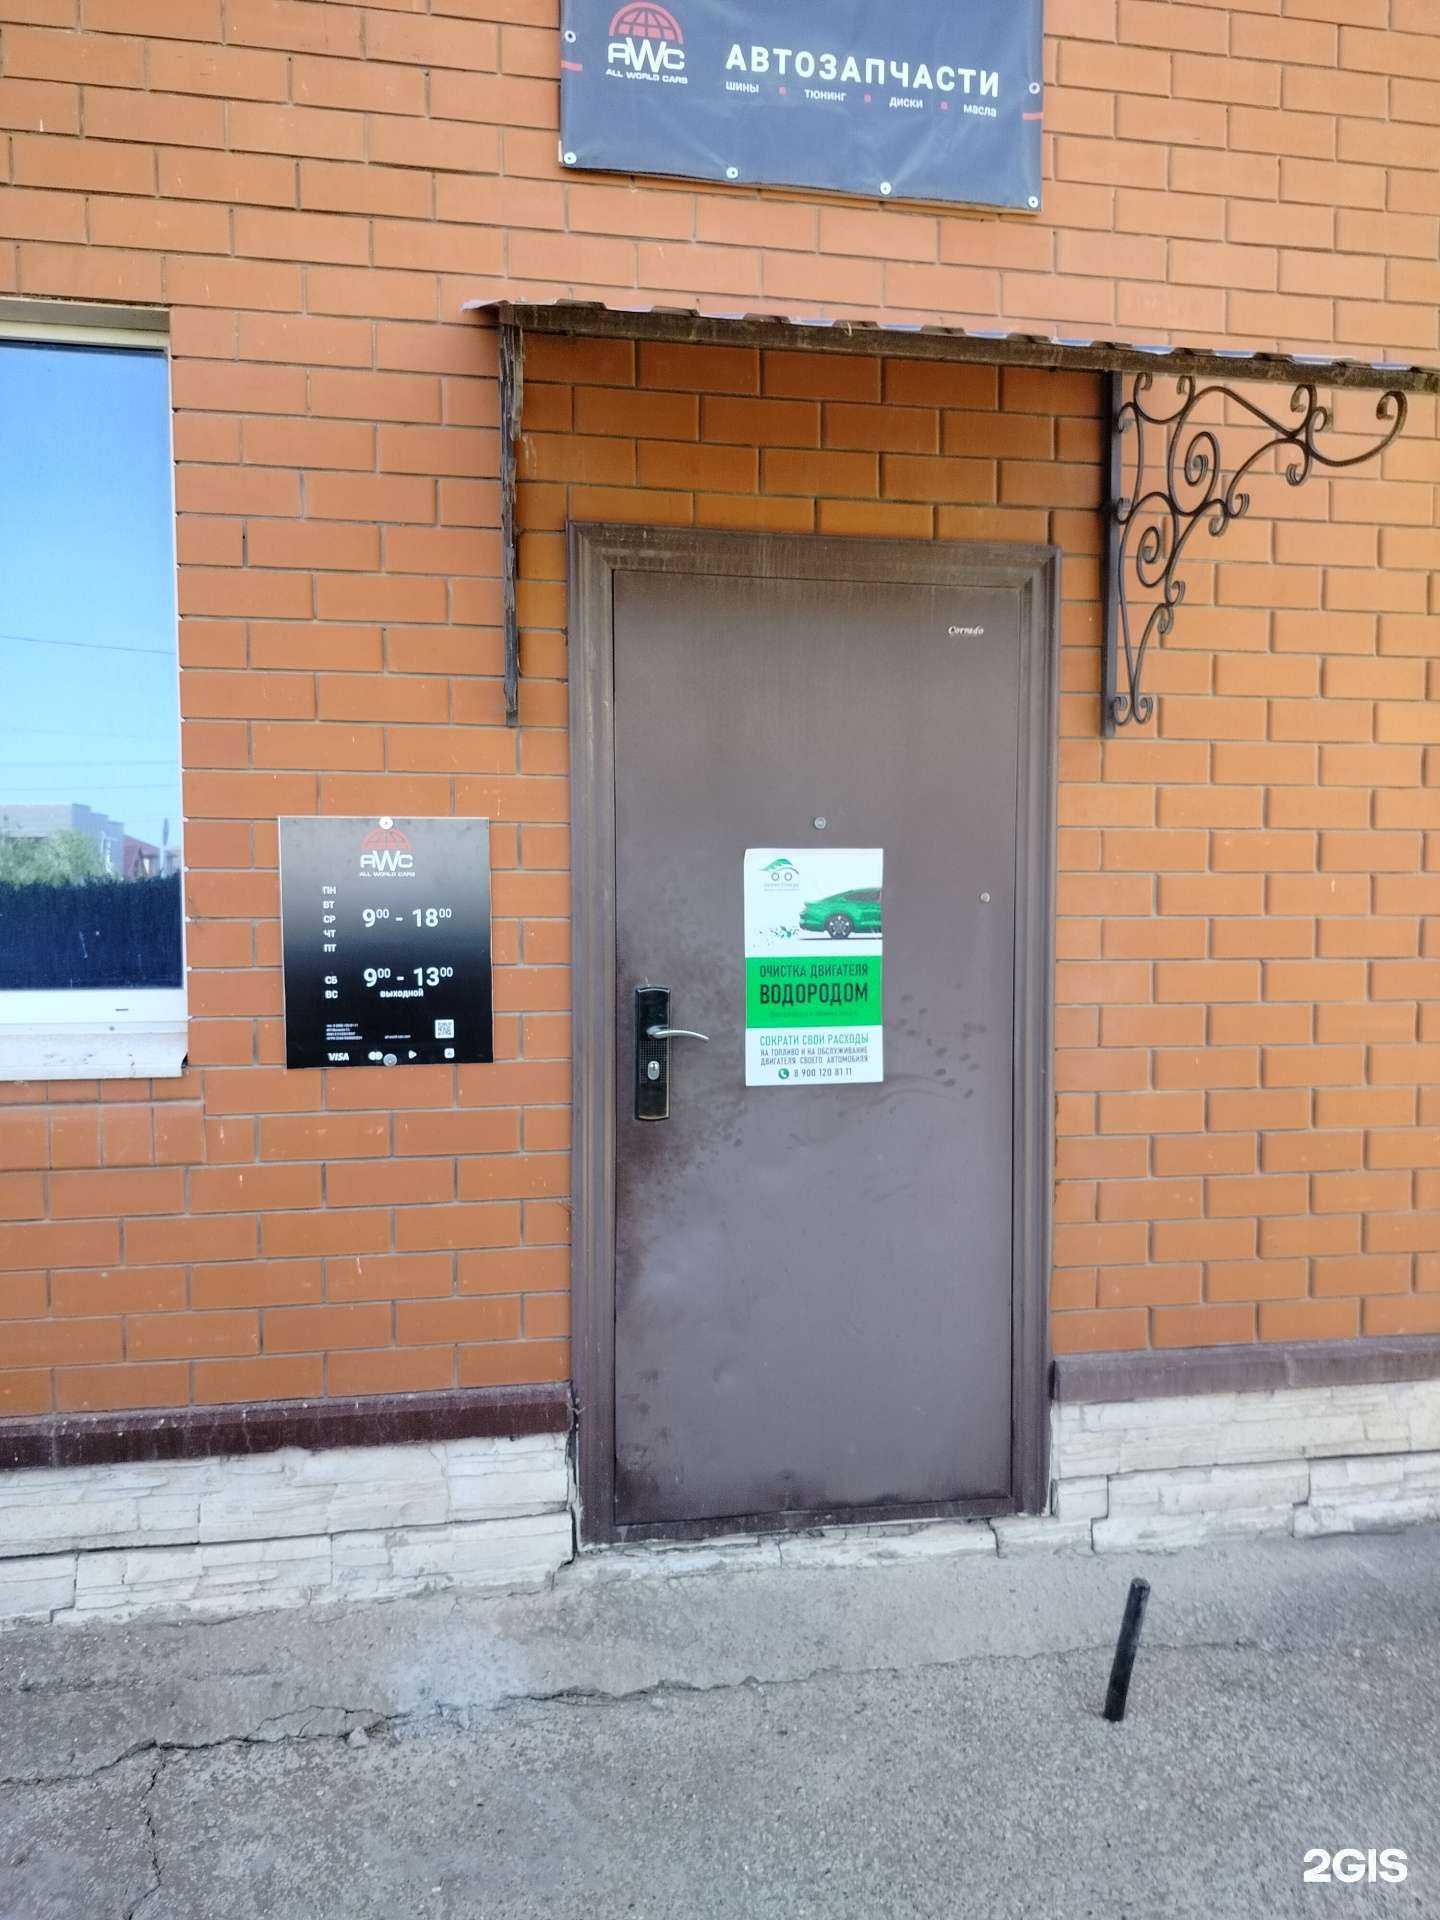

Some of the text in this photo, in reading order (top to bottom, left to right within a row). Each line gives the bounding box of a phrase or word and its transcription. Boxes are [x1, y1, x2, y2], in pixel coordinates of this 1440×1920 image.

[608, 37, 685, 73] AWC
[606, 68, 688, 84] ALL WORLD CARS
[725, 44, 1000, 98] АВТОЗАПЧАСТИ
[725, 81, 998, 118] шины тюнинг диски масла
[359, 850, 413, 871] AWC
[322, 886, 337, 895] ПН
[322, 900, 336, 909] ВТ
[323, 915, 337, 924] СР
[323, 929, 337, 938] ЧТ
[323, 943, 337, 953] ПТ
[760, 963, 868, 978] ОЧИСТКА ДВИГАТЕЛЯ
[324, 976, 338, 985] СБ
[324, 990, 339, 999] ВС
[379, 988, 424, 999] выходной
[759, 982, 868, 1007] ВОДОРОДОМ
[759, 1033, 869, 1047] СОКРАТИ СВОИ РАСХОДЫ
[328, 1052, 350, 1062] VISA
[760, 1048, 769, 1057] НА
[770, 1048, 799, 1056] ТОПЛИВО
[817, 1046, 868, 1055] ОБСЛУЖИВАНИЕ
[759, 1055, 868, 1066] ДВИГАТЕЛЯ СВОЕГО АВТОМОБИЛЯ
[801, 1069, 816, 1078] 900
[818, 1068, 832, 1077] 120
